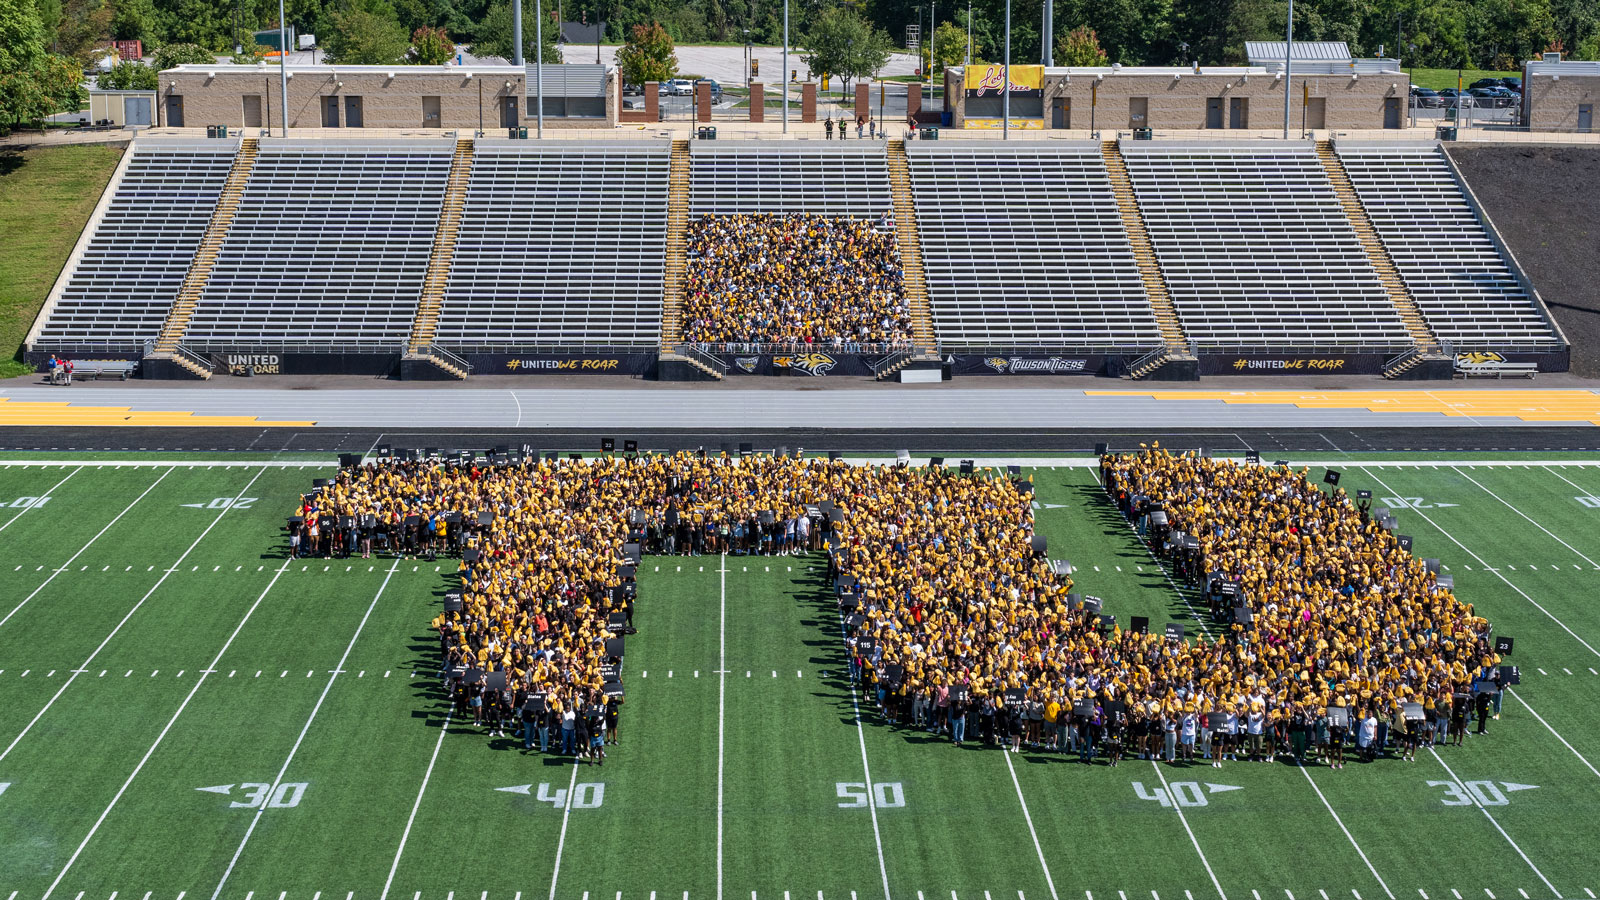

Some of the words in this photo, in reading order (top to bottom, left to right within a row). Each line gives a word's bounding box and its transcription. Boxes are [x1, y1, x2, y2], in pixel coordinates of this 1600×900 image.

[228, 354, 279, 365] UNITED
[581, 359, 619, 371] ROAR
[1307, 359, 1344, 371] ROAR
[860, 641, 871, 649] 115
[229, 783, 309, 808] 30
[535, 783, 605, 808] 40
[835, 782, 905, 808] 50
[1131, 781, 1209, 808] 40
[1425, 780, 1509, 806] 30
